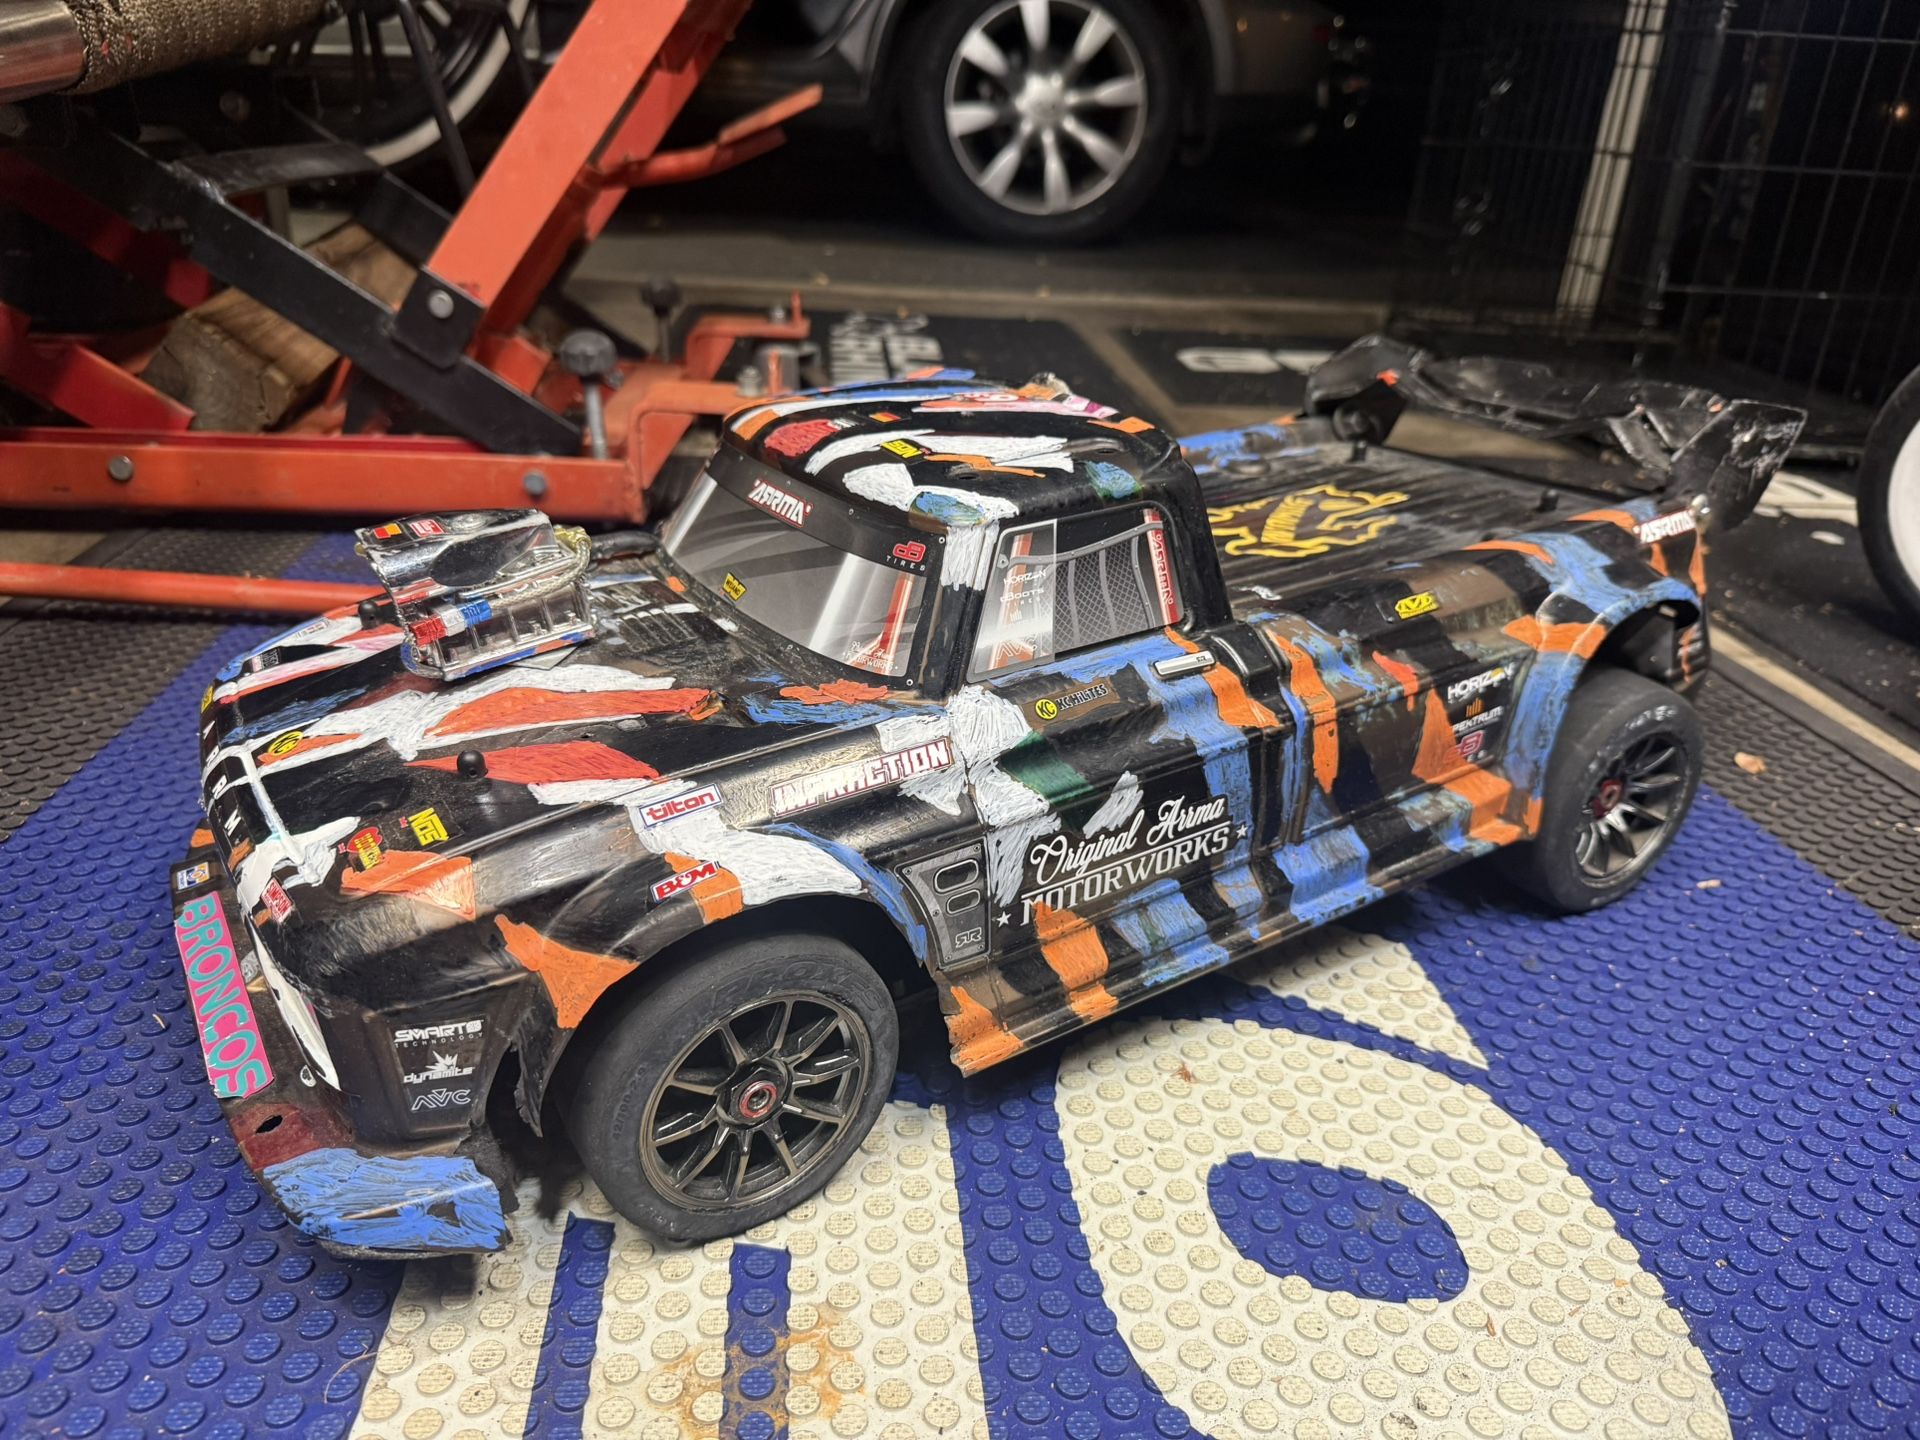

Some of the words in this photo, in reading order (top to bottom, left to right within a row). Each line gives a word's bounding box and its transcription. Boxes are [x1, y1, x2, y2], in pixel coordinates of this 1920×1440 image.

[886, 555, 926, 571] TIRES
[1036, 700, 1058, 719] KC
[1056, 697, 1071, 710] KC
[772, 740, 951, 817] INFRACTION
[646, 791, 715, 821] tilton
[1030, 808, 1145, 885] Original
[1146, 795, 1226, 846] Arrma
[656, 862, 718, 900] B&M
[1020, 826, 1231, 926] MOTORWORKS
[177, 893, 269, 1098] BRONCOS
[395, 1033, 484, 1048] TECHNOLOGY
[403, 1067, 475, 1084] dynamite
